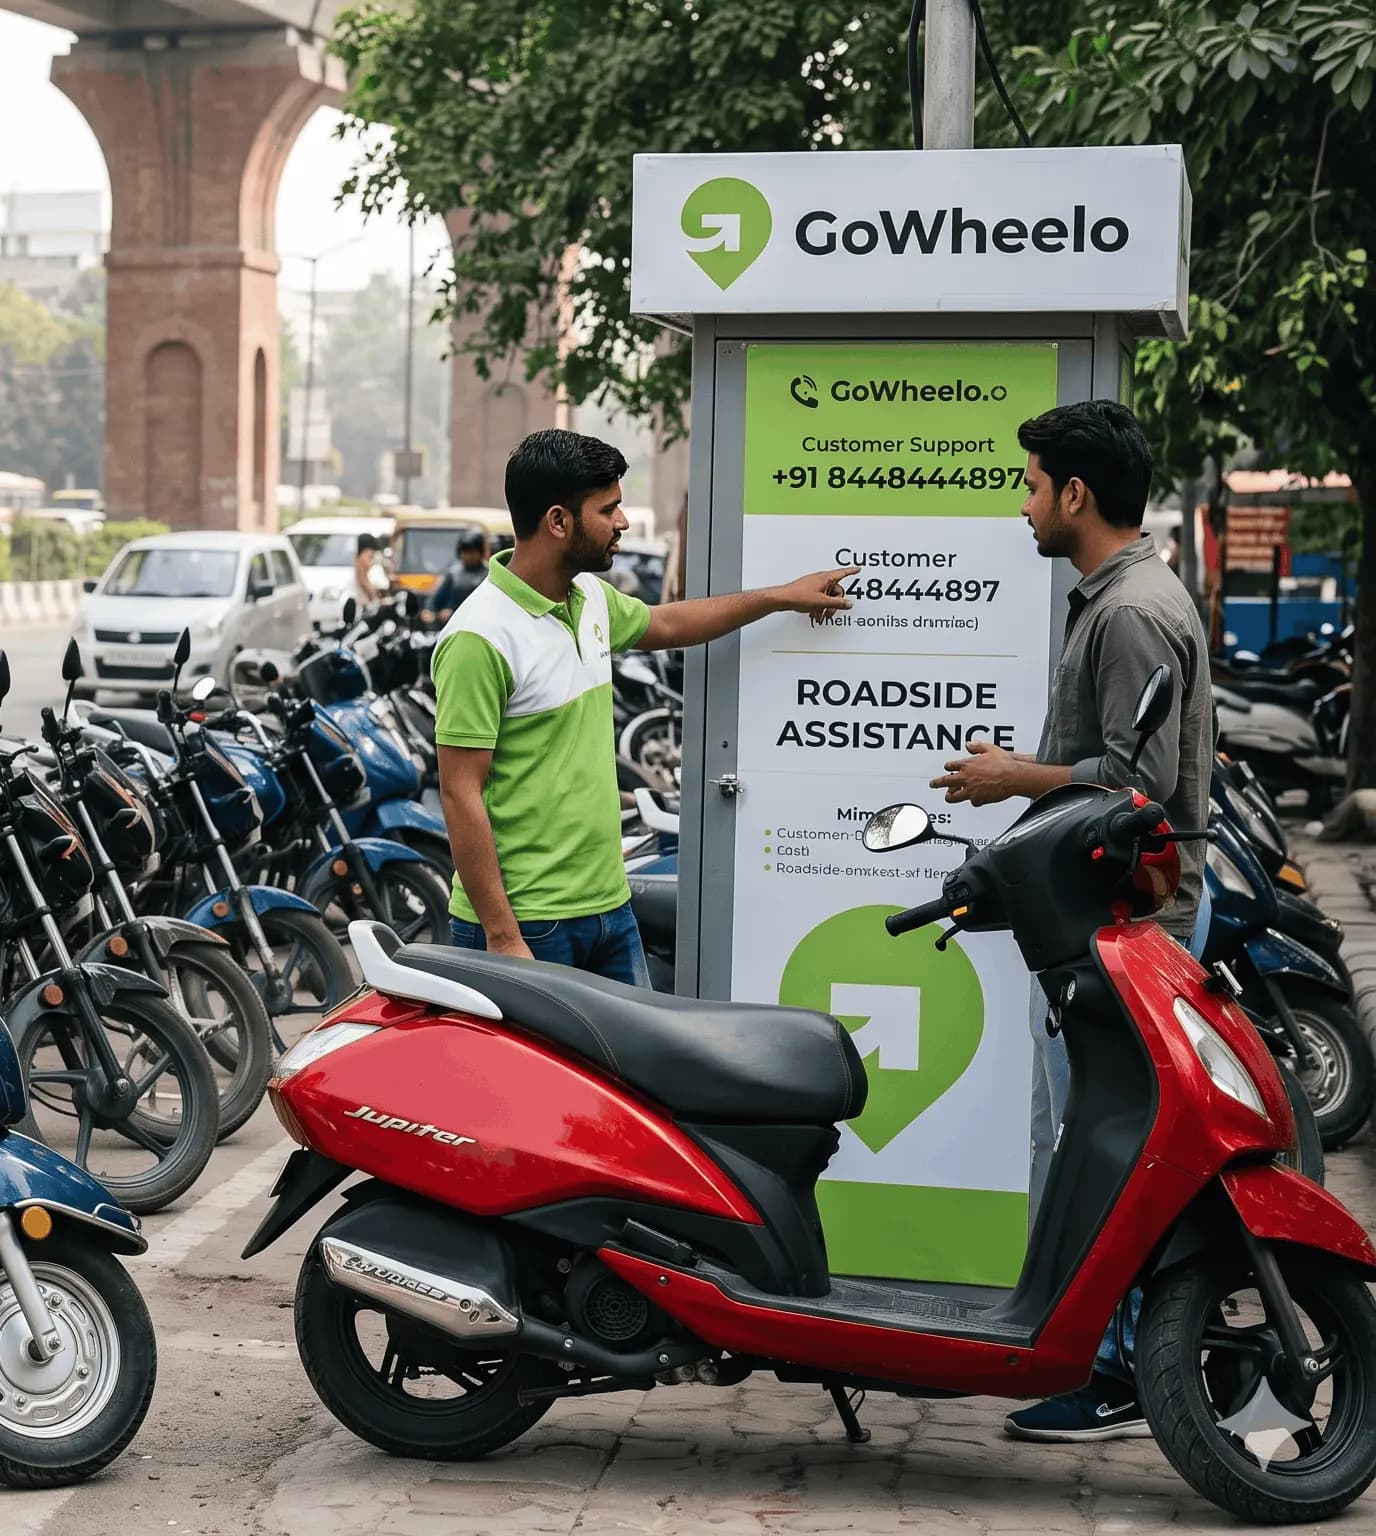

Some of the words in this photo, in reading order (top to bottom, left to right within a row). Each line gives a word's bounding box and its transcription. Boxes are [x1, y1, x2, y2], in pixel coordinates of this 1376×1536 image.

[795, 204, 1130, 256] GoWheelo
[801, 436, 905, 453] Customer
[909, 436, 995, 457] Support
[772, 466, 817, 489] +91
[827, 466, 1026, 490] 8448444897
[835, 548, 957, 568] Customer
[841, 578, 1000, 602] 48444897
[796, 678, 998, 710] ROADSIDE
[775, 719, 1015, 754] ASSISTANCE
[343, 1105, 477, 1147] Jupiter
